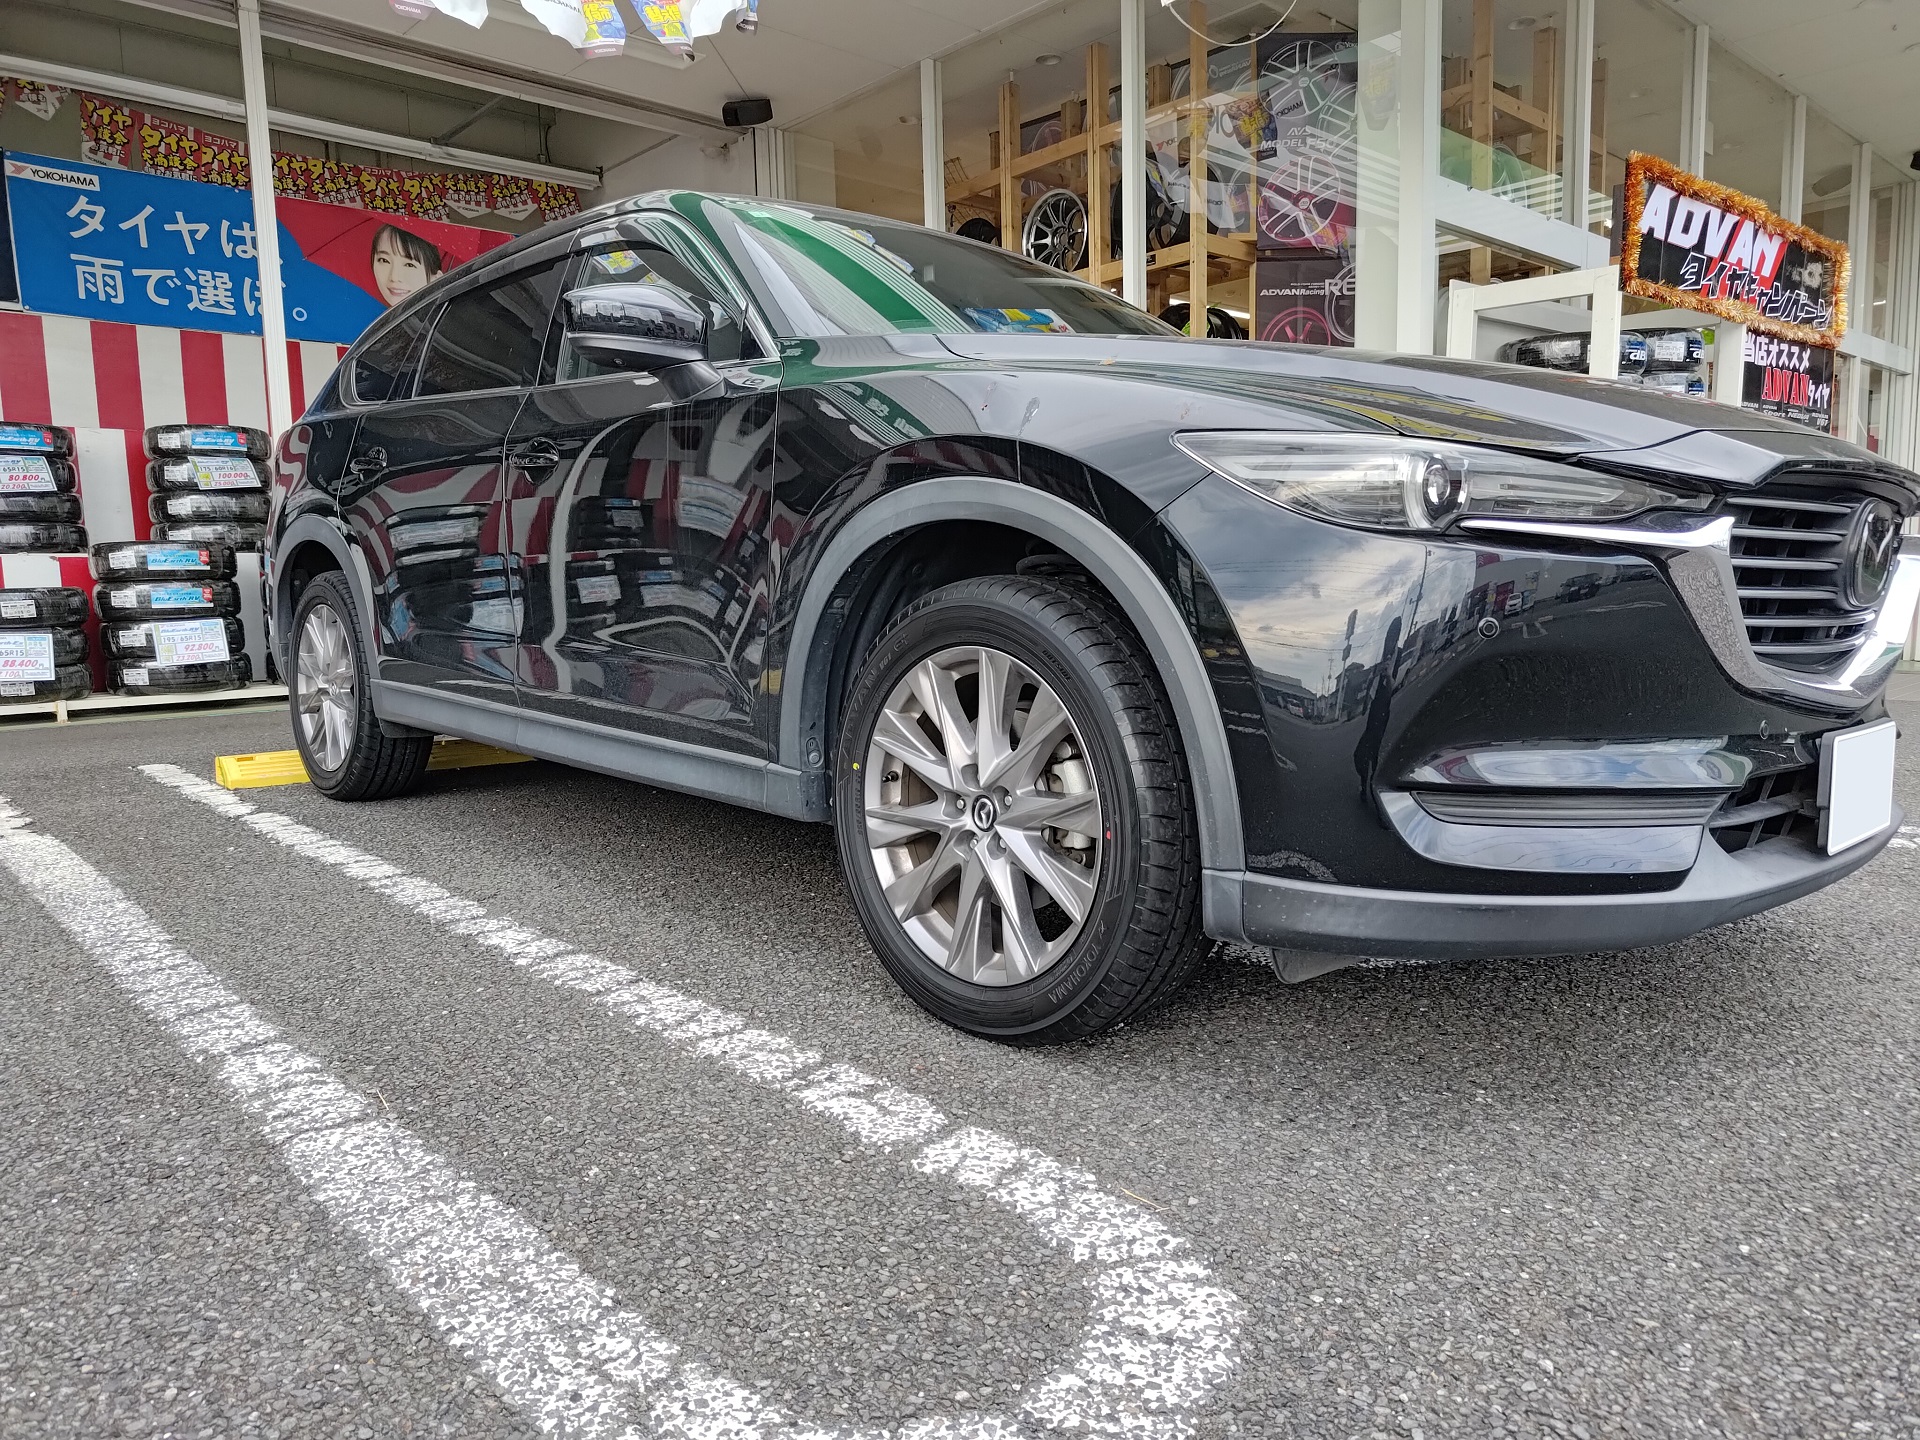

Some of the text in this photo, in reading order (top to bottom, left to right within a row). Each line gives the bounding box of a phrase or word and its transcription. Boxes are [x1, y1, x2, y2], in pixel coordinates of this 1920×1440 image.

[140, 124, 200, 156] タイヤ
[152, 117, 186, 132] ヨコハマ
[204, 135, 238, 149] ヨコハマ
[30, 168, 96, 188] YOKOHAMA
[66, 195, 284, 266] タイヤは
[1639, 184, 1785, 278] ADVAN
[1744, 331, 1811, 373] 当店オススメ
[1047, 942, 1100, 1005] YOKOHAMA
